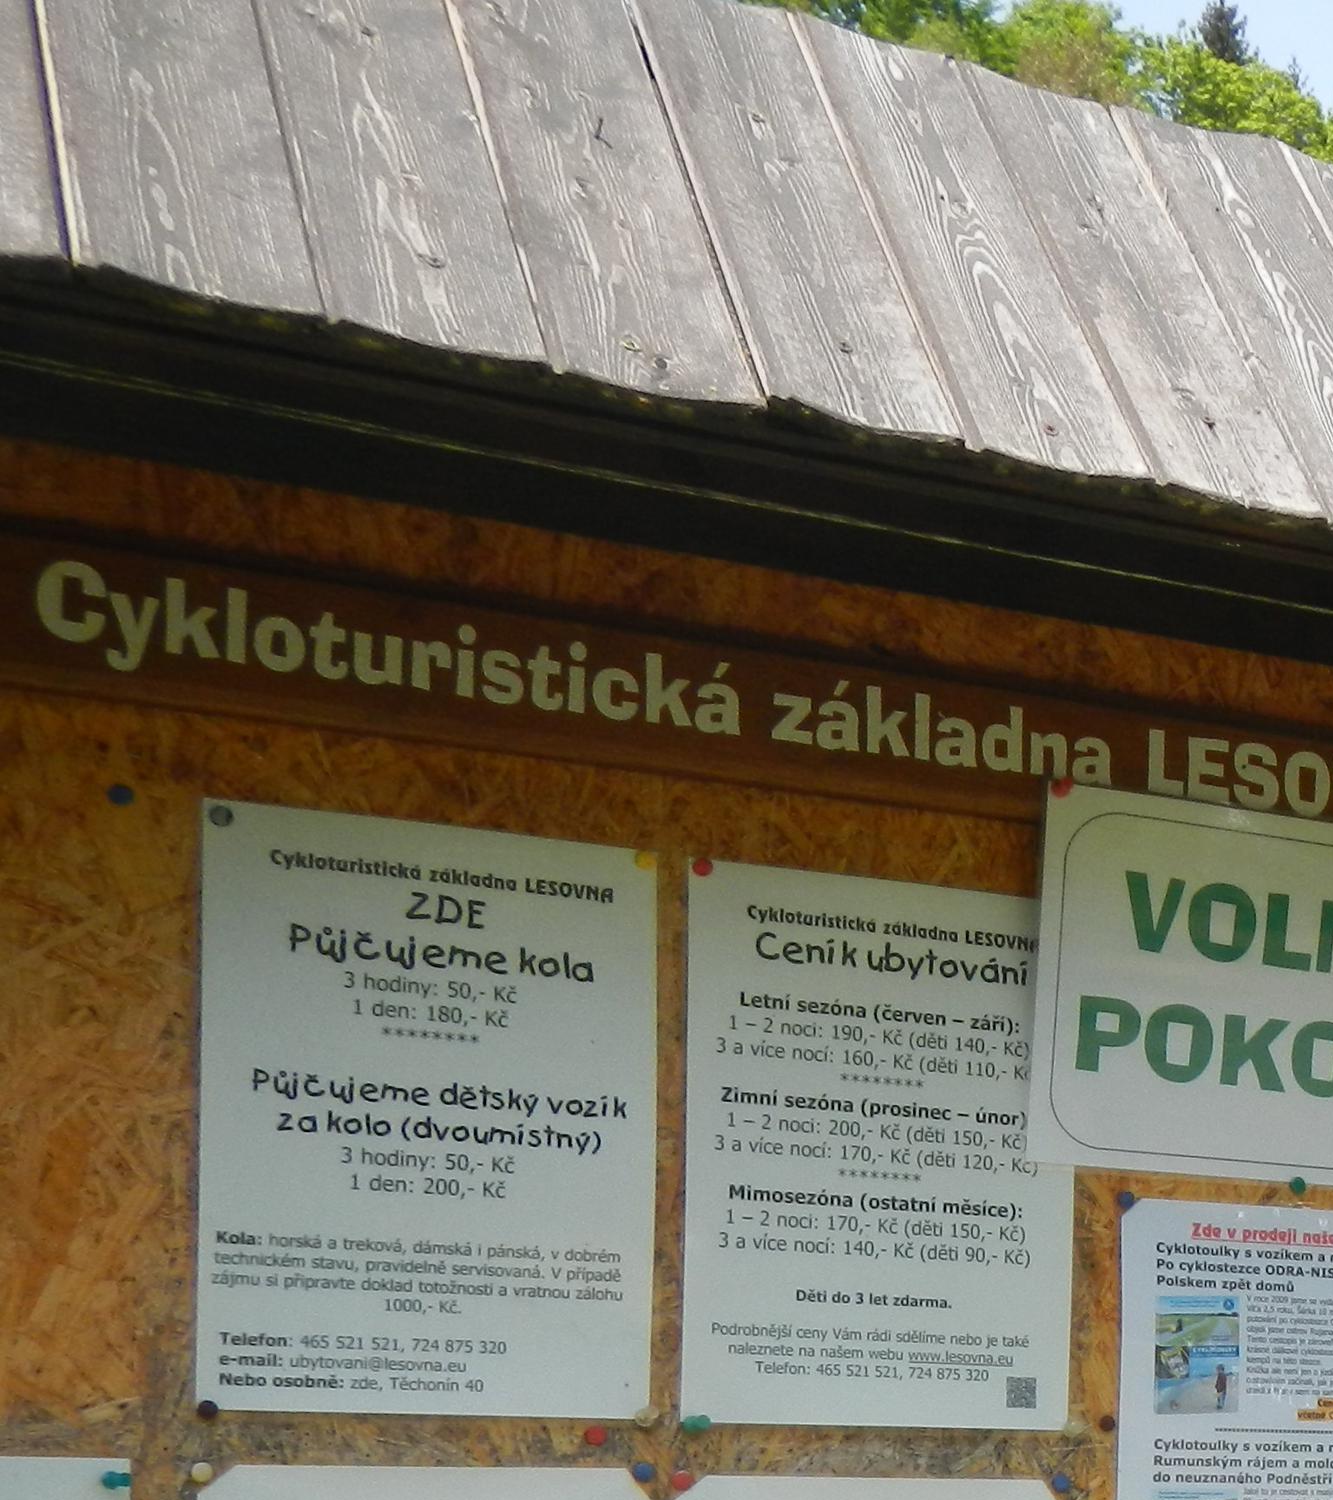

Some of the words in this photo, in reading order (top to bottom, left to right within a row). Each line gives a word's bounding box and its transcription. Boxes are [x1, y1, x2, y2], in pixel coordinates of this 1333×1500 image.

[36, 560, 741, 736] Cykloturistická
[771, 681, 1112, 784] základna
[269, 848, 421, 880] Cykloturistická
[428, 868, 516, 891] základna
[524, 877, 613, 903] LESOVNA
[405, 891, 486, 929] ZDE
[746, 904, 876, 933] Cykloturistická
[882, 921, 958, 942] základna
[288, 922, 508, 975] Půjčujeme
[519, 946, 594, 982] kola
[755, 931, 857, 967] Ceník
[866, 941, 1027, 986] ubytování
[343, 970, 355, 988] 3
[363, 972, 437, 998] hodiny:
[447, 980, 485, 1002] 50,-
[493, 985, 516, 1004] Kč
[353, 998, 362, 1015] 1
[371, 1000, 416, 1019] den:
[427, 1004, 477, 1026] 180,-
[485, 1009, 508, 1028] Kč
[739, 991, 789, 1010] Letní
[796, 998, 866, 1018] sezóna
[873, 1003, 946, 1026] (červen
[970, 1014, 1019, 1034] září):
[729, 1014, 737, 1030] 1
[762, 1016, 773, 1033] 2
[780, 1022, 822, 1038] noci:
[832, 1024, 875, 1045] 190,-
[882, 1028, 902, 1046] Kč
[908, 1031, 947, 1050] (děti
[955, 1036, 997, 1056] 140,-
[1003, 1040, 1030, 1059] Kč)
[252, 1068, 430, 1106] Půjčujeme
[439, 1082, 539, 1118] dětský
[546, 1095, 626, 1119] vozík
[276, 1112, 317, 1132] za
[326, 1110, 391, 1136] kolo
[400, 1116, 601, 1155] (dvoumístný)
[350, 1173, 360, 1190] 1
[368, 1174, 413, 1193] den:
[423, 1177, 474, 1198] 200,-
[482, 1180, 505, 1198] Kč
[729, 1184, 852, 1207] Mimosezóna
[860, 1192, 935, 1212] (ostatní
[942, 1198, 1022, 1221] měsíce):
[215, 1230, 262, 1245] Kola:
[268, 1233, 321, 1248] horská
[326, 1238, 337, 1250] a
[342, 1237, 406, 1255] treková,
[412, 1240, 472, 1256] dámská
[477, 1243, 481, 1256] i
[486, 1243, 545, 1262] pánská,
[550, 1250, 559, 1259] v
[563, 1248, 621, 1263] dobrém
[1191, 1222, 1221, 1239] Zde
[1227, 1228, 1237, 1239] v
[1242, 1227, 1297, 1245] prodeji
[1156, 1241, 1239, 1259] Cyklotoulky
[1244, 1249, 1252, 1258] s
[1256, 1248, 1313, 1261] vozíkem
[1317, 1253, 1325, 1262] a
[1156, 1258, 1174, 1270] Po
[1178, 1260, 1260, 1274] cyklostezce
[213, 1251, 305, 1267] technickém
[310, 1256, 358, 1272] stavu,
[364, 1259, 446, 1274] pravidelně
[451, 1263, 544, 1279] servisovaná.
[550, 1266, 562, 1279] V
[566, 1266, 621, 1283] případě
[795, 1288, 826, 1302] Děti
[831, 1290, 850, 1304] do
[855, 1292, 864, 1304] 3
[869, 1292, 888, 1306] let
[892, 1294, 951, 1308] zdarma.
[1156, 1274, 1216, 1288] Polskem
[1221, 1278, 1251, 1291] zpět
[1255, 1279, 1294, 1292] domů
[218, 1331, 292, 1347] Telefon:
[299, 1334, 329, 1349] 465
[335, 1335, 363, 1350] 521
[370, 1336, 404, 1352] 521,
[411, 1337, 439, 1352] 724
[444, 1338, 473, 1353] 875
[478, 1340, 506, 1354] 320
[711, 1321, 792, 1340] Podrobnější
[795, 1328, 828, 1342] ceny
[832, 1326, 862, 1340] Vám
[866, 1328, 891, 1342] rádi
[895, 1329, 946, 1344] sdělíme
[949, 1332, 982, 1346] nebo
[984, 1336, 998, 1348] je
[1001, 1334, 1029, 1348] také
[218, 1352, 283, 1367] e-mail:
[289, 1354, 466, 1372] ubytovani@lesovna.eu
[727, 1341, 794, 1356] naleznete
[798, 1346, 815, 1357] na
[819, 1344, 864, 1359] našem
[867, 1347, 903, 1360] webu
[907, 1350, 1013, 1367] www.lesovna.eu
[218, 1372, 267, 1386] Nebo
[271, 1374, 344, 1388] osobně:
[349, 1376, 382, 1391] zde,
[389, 1376, 459, 1391] Těchonín
[464, 1378, 483, 1392] 40
[1154, 1438, 1238, 1453] Cyklotoulky
[1242, 1442, 1250, 1451] s
[1254, 1439, 1311, 1452] vozíkem
[1316, 1443, 1324, 1452] a
[1153, 1454, 1242, 1469] Rumunským
[1246, 1455, 1287, 1470] rájem
[1291, 1459, 1299, 1468] a
[1152, 1471, 1170, 1482] do
[1175, 1471, 1262, 1484] neuznaného
[1266, 1472, 1332, 1484] Podněstří
